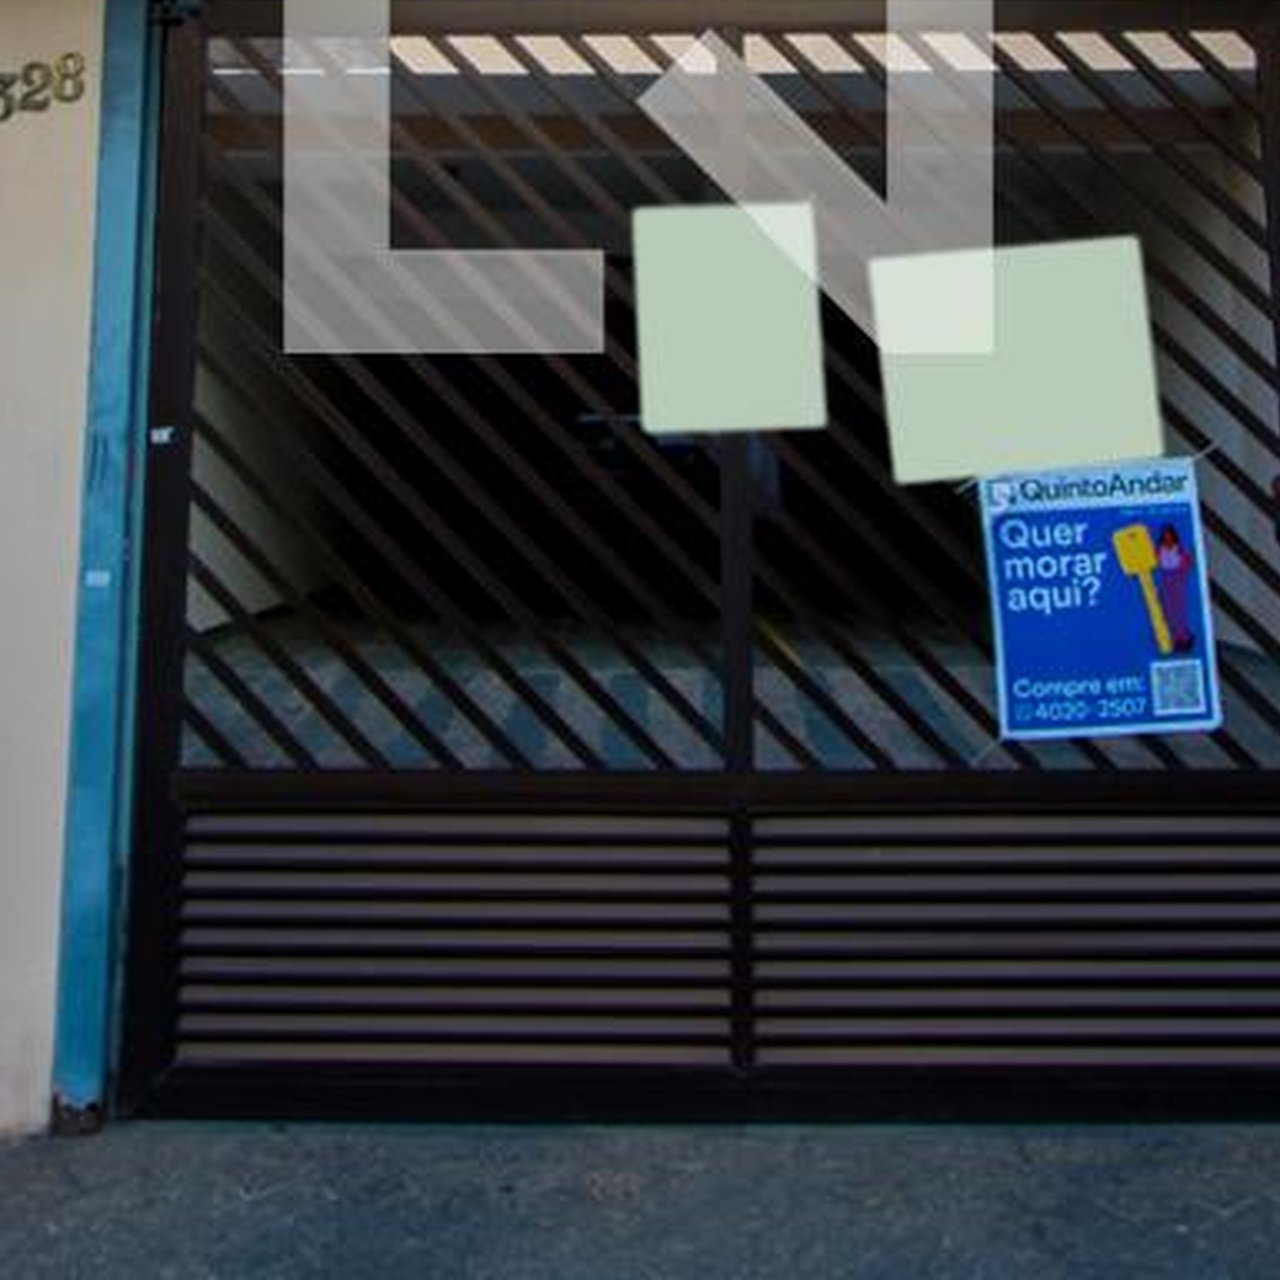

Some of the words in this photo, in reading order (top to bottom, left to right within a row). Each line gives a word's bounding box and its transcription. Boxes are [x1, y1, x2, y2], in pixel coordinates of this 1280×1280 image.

[1020, 472, 1188, 502] QuintoAndar
[999, 519, 1089, 549] Quer
[1003, 552, 1108, 580] morar
[1007, 577, 1101, 616] aqui?
[1012, 677, 1101, 700] Compre
